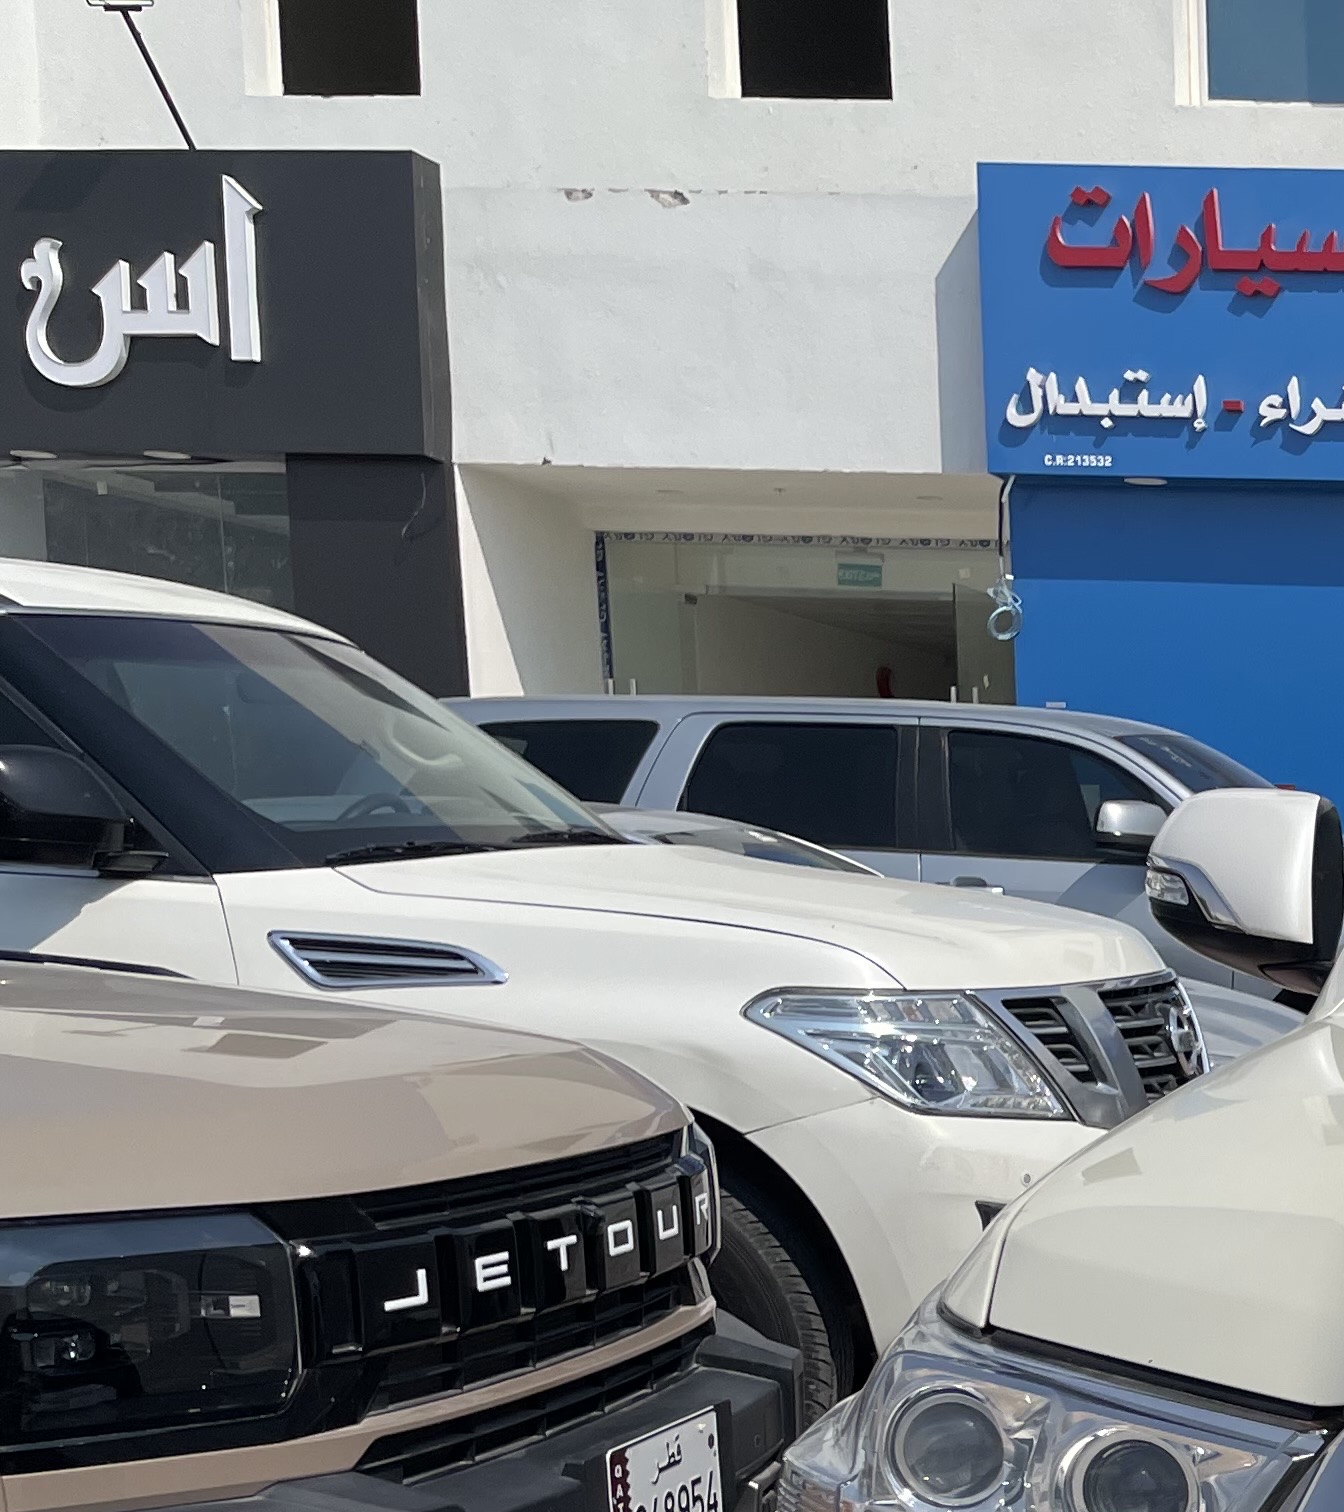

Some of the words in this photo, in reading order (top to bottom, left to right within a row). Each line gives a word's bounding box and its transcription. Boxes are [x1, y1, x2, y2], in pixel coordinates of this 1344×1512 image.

[1006, 367, 1209, 432] إستبدال
[384, 1192, 708, 1313] JETOUR
[652, 1434, 683, 1485] قطر
